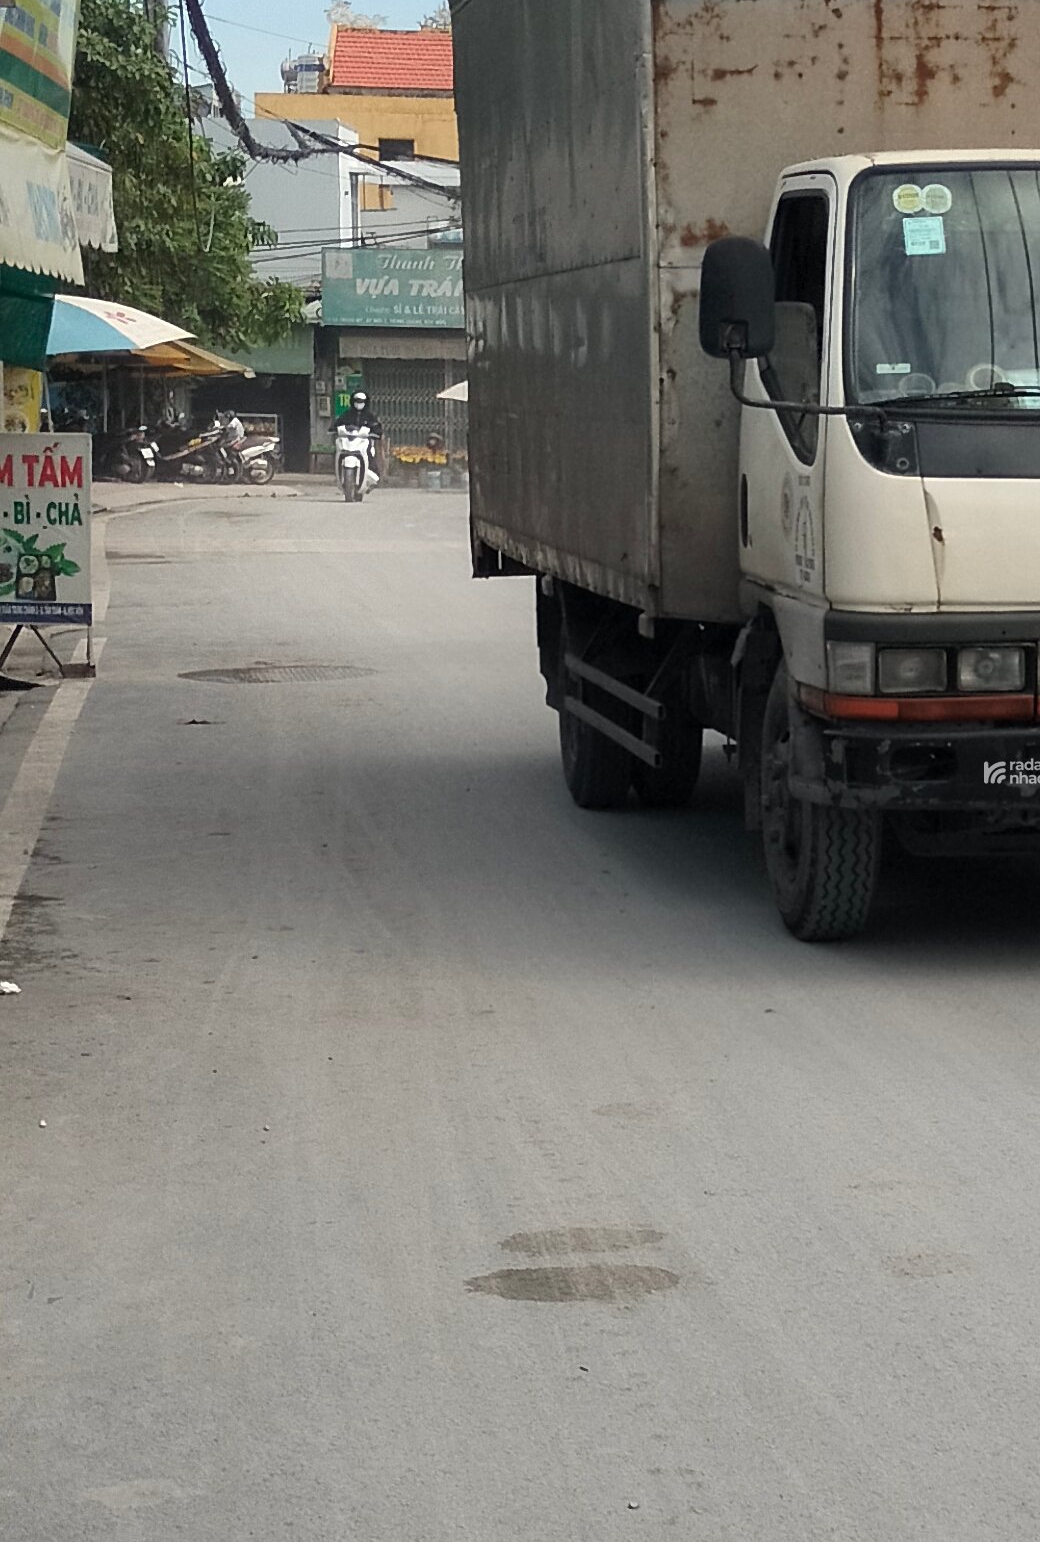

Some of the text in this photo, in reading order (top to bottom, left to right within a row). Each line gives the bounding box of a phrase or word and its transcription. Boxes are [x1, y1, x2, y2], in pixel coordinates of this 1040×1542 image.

[356, 275, 399, 298] VỰA
[22, 442, 83, 488] TẤM
[13, 494, 31, 525] BÌ
